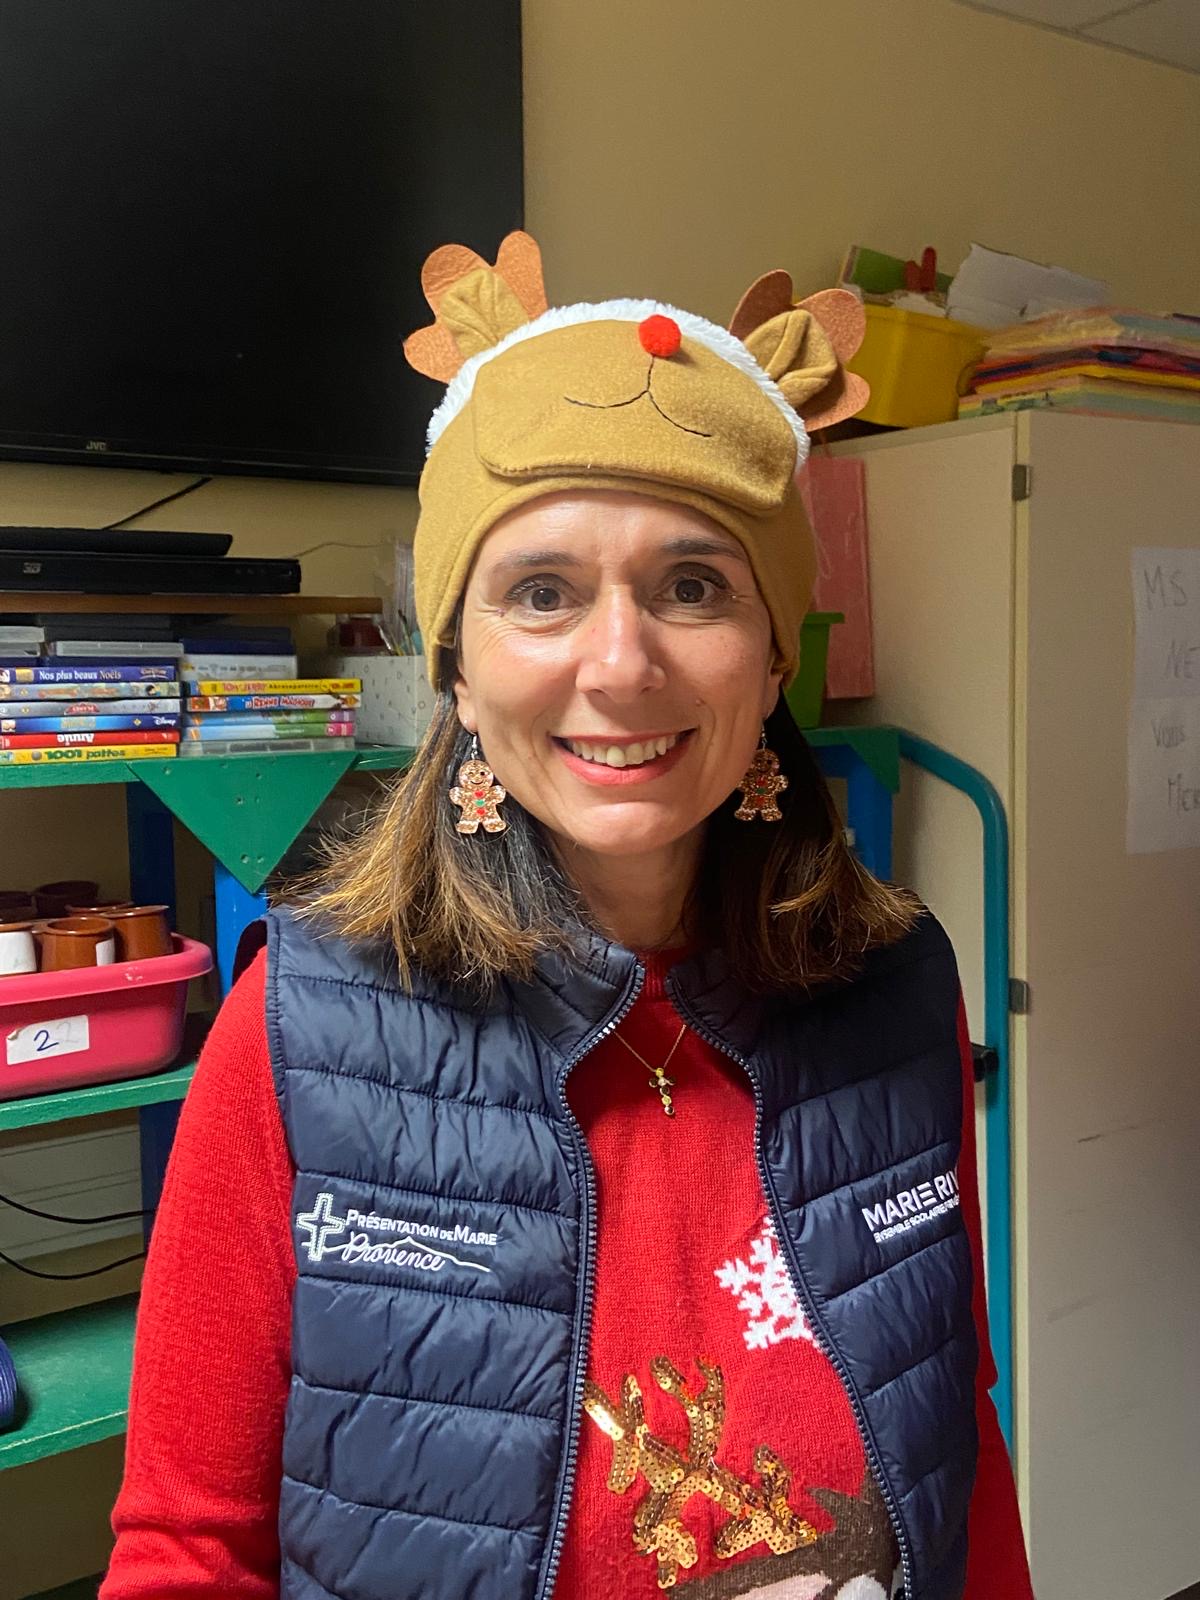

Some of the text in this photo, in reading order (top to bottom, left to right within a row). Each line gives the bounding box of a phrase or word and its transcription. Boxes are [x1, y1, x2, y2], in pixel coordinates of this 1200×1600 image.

[86, 440, 107, 451] JVC
[39, 670, 54, 680] Nos
[56, 669, 72, 682] plus
[74, 670, 98, 680] beaux
[152, 716, 177, 726] Disney
[57, 733, 95, 745] Annie
[44, 748, 82, 760] 1001
[33, 1029, 59, 1052] 2
[861, 1182, 938, 1232] MARIE
[346, 1208, 439, 1237] PRÉSENTATION
[454, 1224, 498, 1246] MARIE
[341, 1231, 446, 1271] Provence
